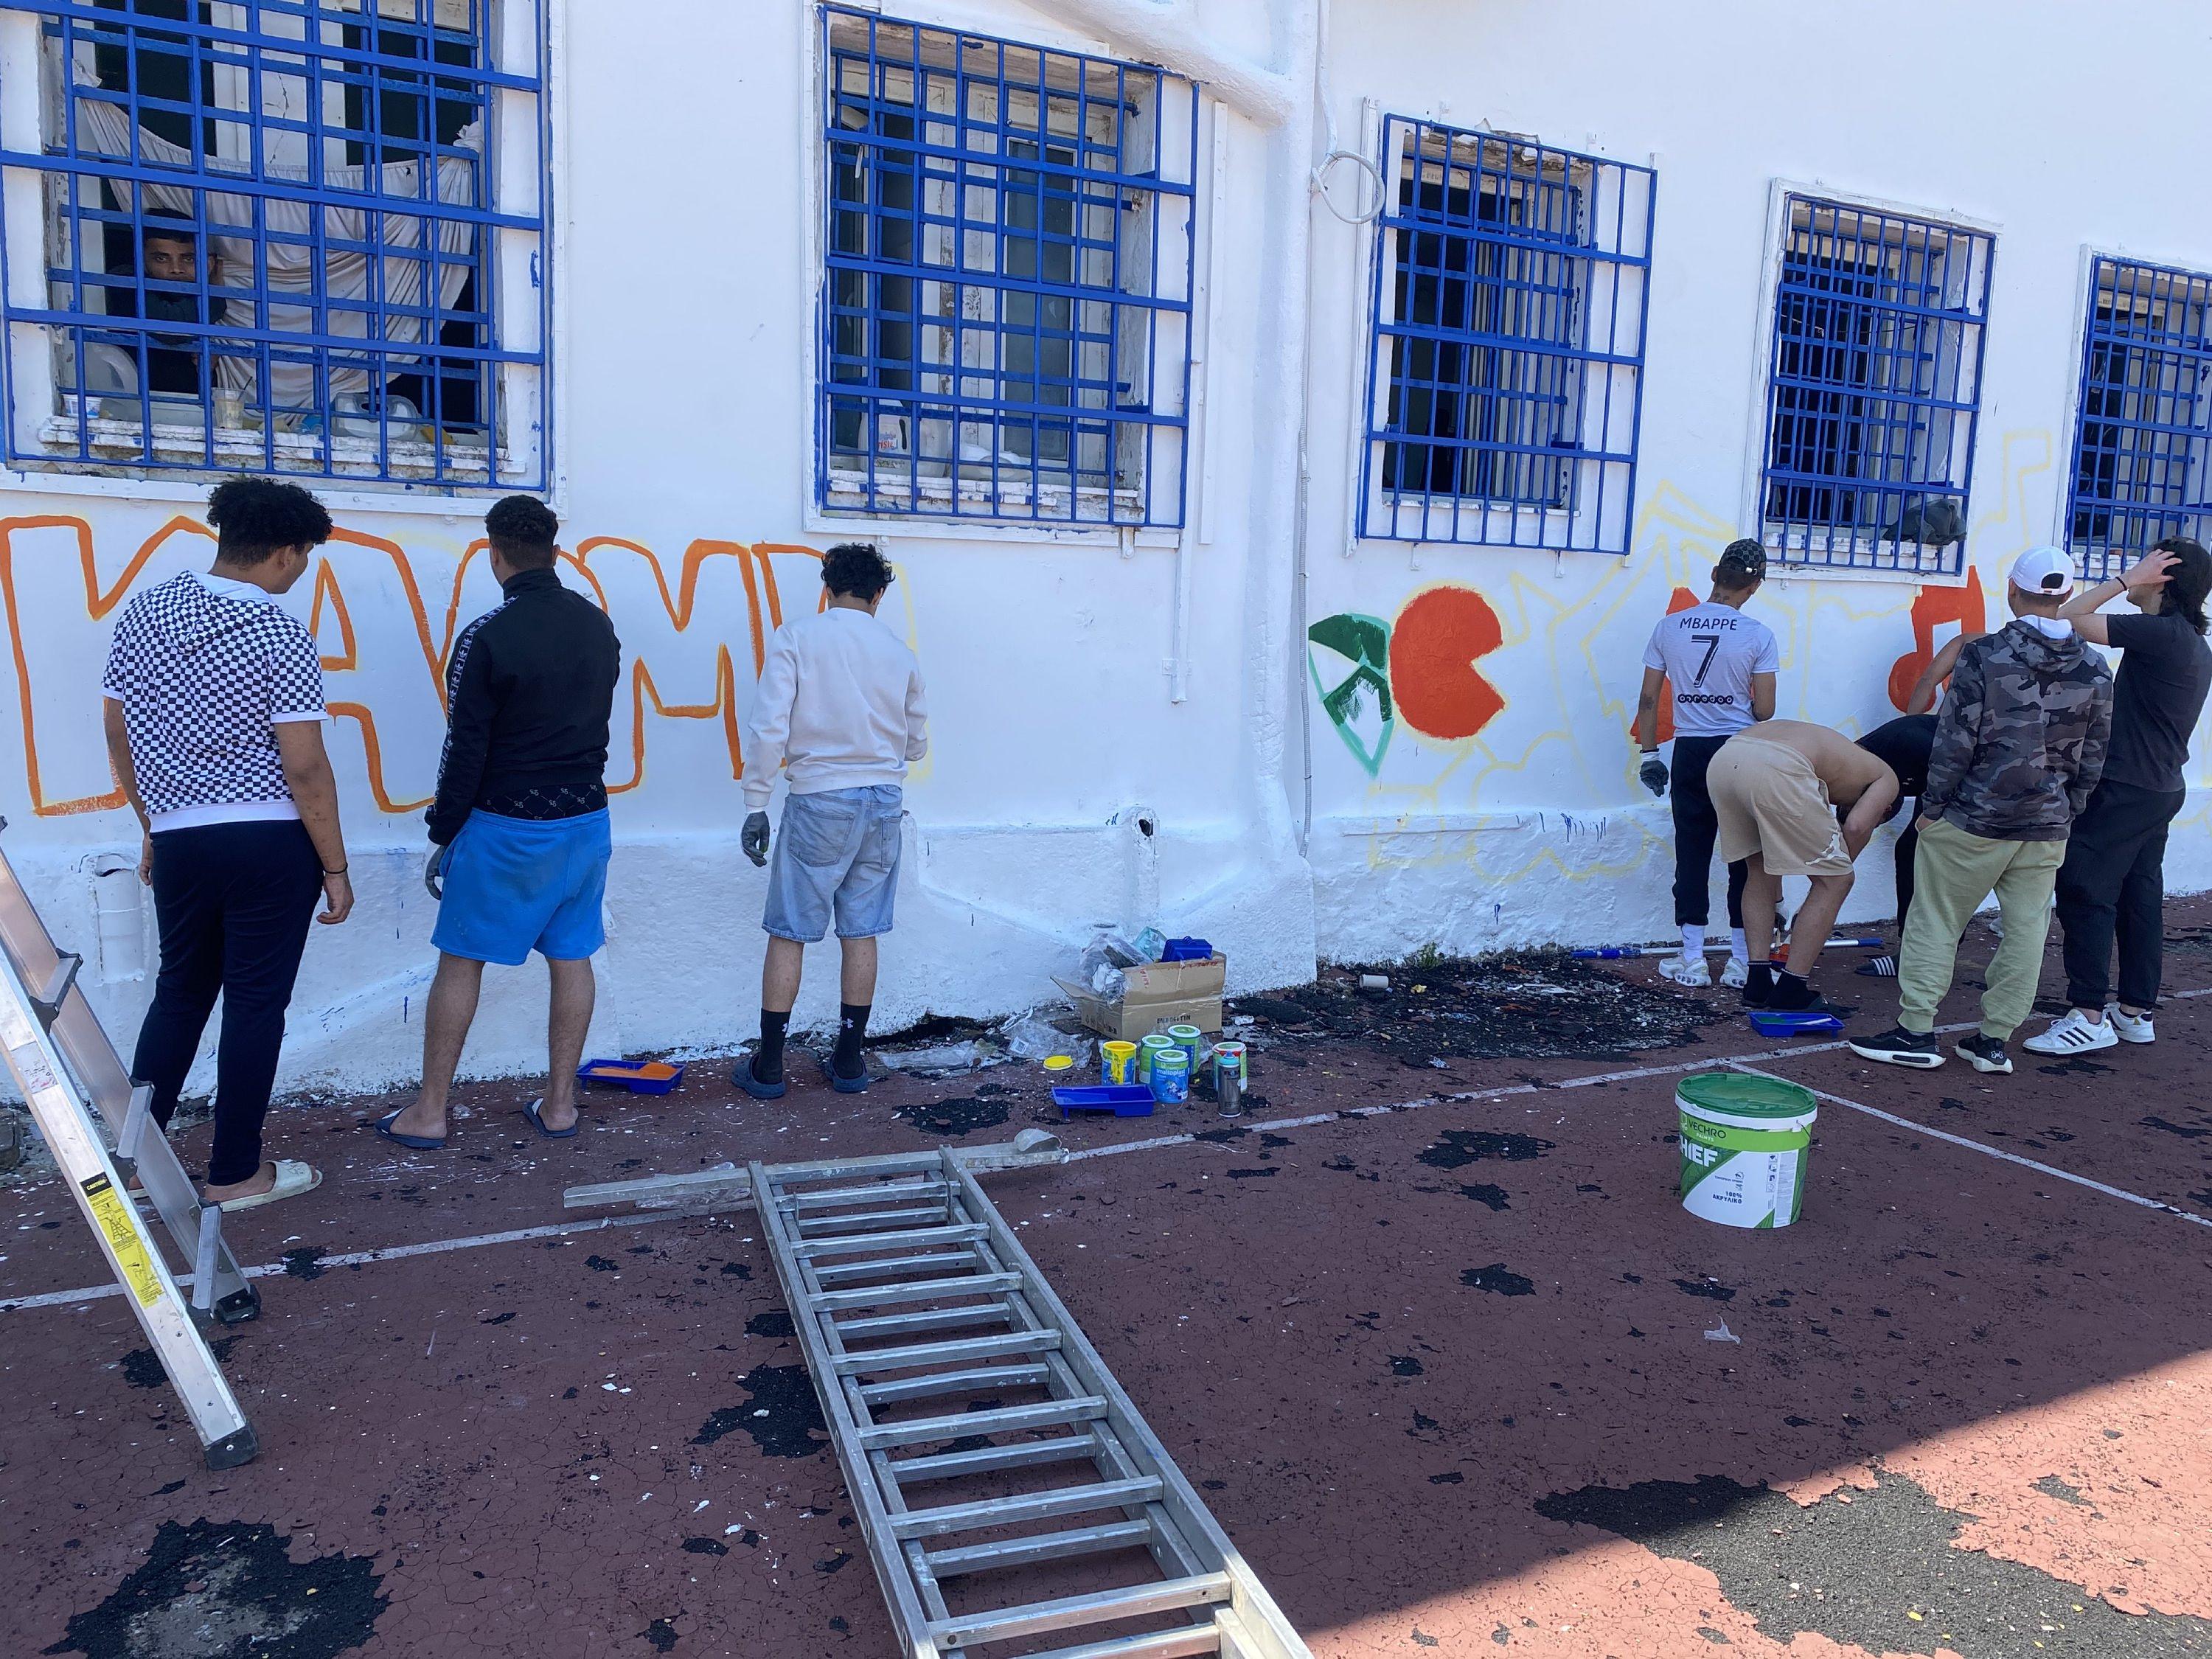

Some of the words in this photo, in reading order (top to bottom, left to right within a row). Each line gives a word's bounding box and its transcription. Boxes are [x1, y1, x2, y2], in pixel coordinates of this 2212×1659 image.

[1691, 634, 1719, 688] 7
[1677, 694, 1733, 705] ooredoo
[1688, 1119, 1727, 1139] VECHRO
[1680, 1134, 1718, 1167] HIEF
